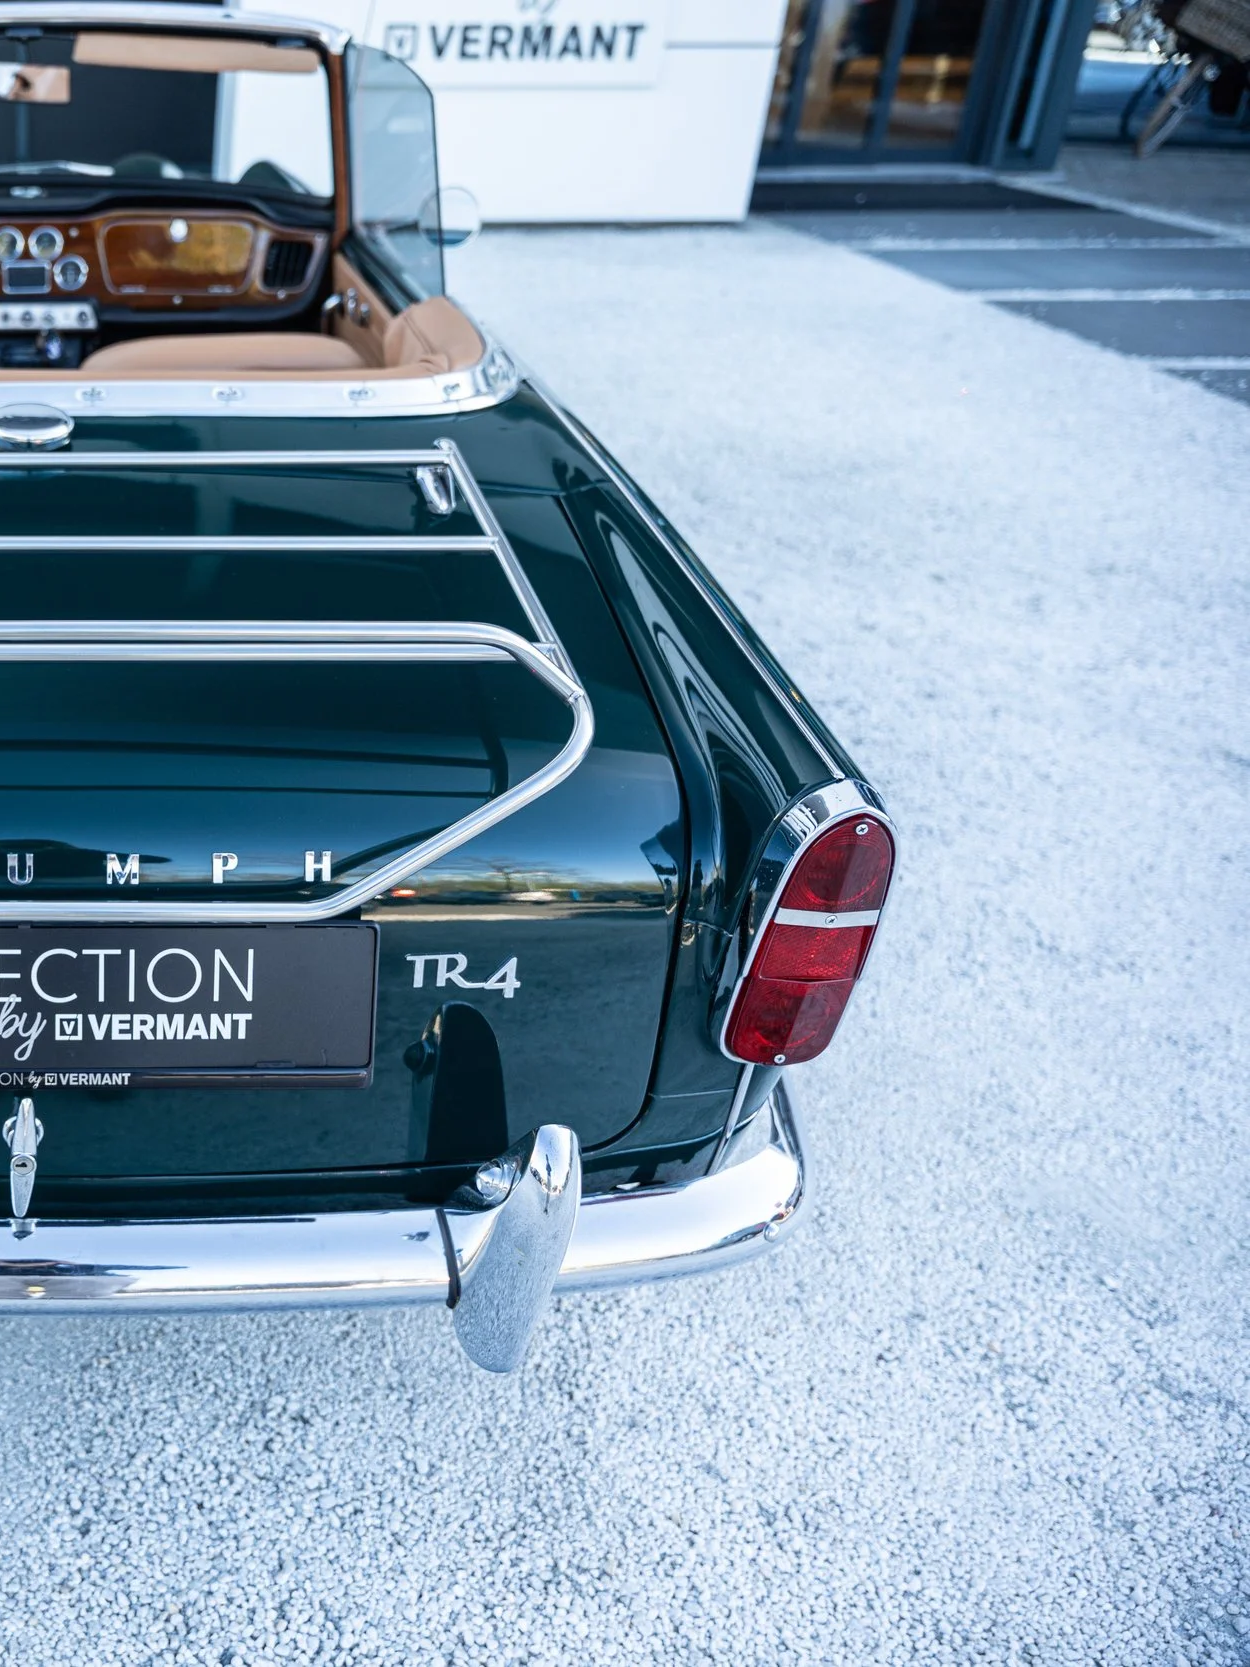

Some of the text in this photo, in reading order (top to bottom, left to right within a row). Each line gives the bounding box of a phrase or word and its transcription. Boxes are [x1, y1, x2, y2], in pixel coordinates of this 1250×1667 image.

[429, 24, 644, 60] VERMANT
[405, 952, 521, 998] TR4
[87, 1013, 252, 1040] VERMANT
[28, 1071, 42, 1088] by
[60, 1073, 131, 1085] VERMANT
